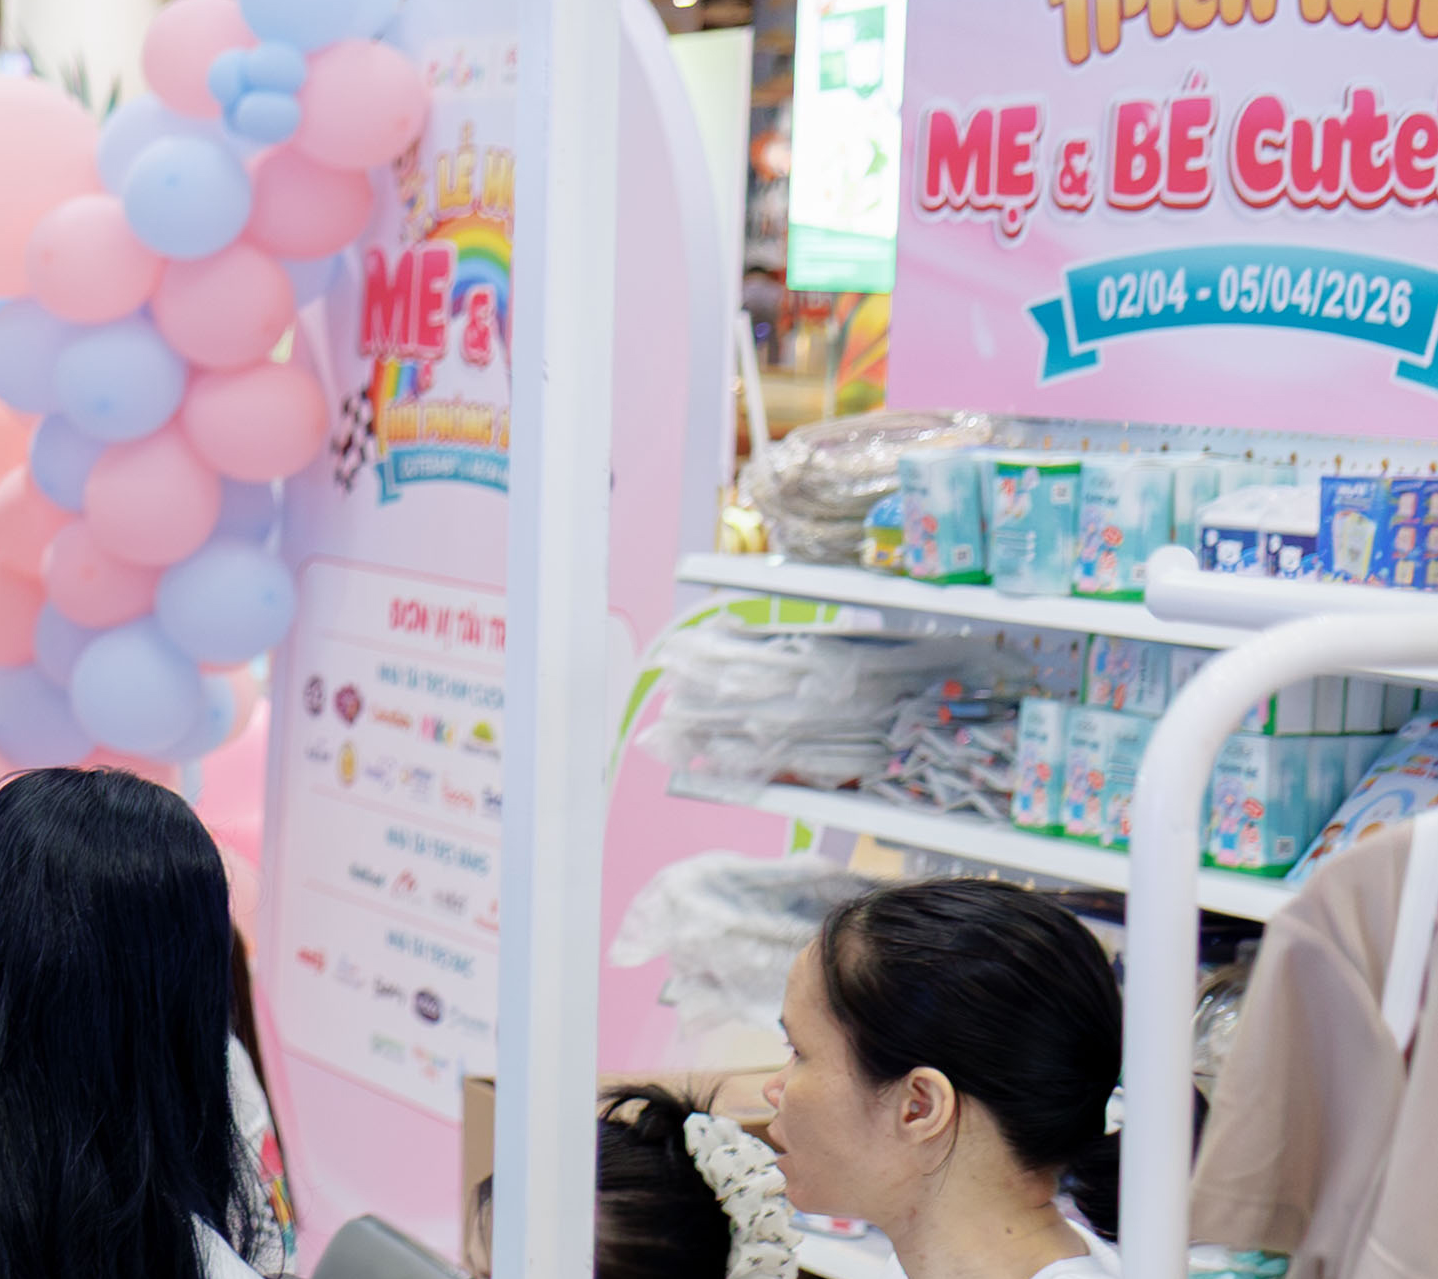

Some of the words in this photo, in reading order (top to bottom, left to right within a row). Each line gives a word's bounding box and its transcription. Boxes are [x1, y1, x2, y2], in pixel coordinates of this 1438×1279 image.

[924, 103, 1041, 236] MẸ
[1056, 138, 1092, 210] &
[1111, 70, 1216, 211] BÉ
[1097, 264, 1190, 321] 02/04
[1218, 264, 1412, 329] 05/04/2026
